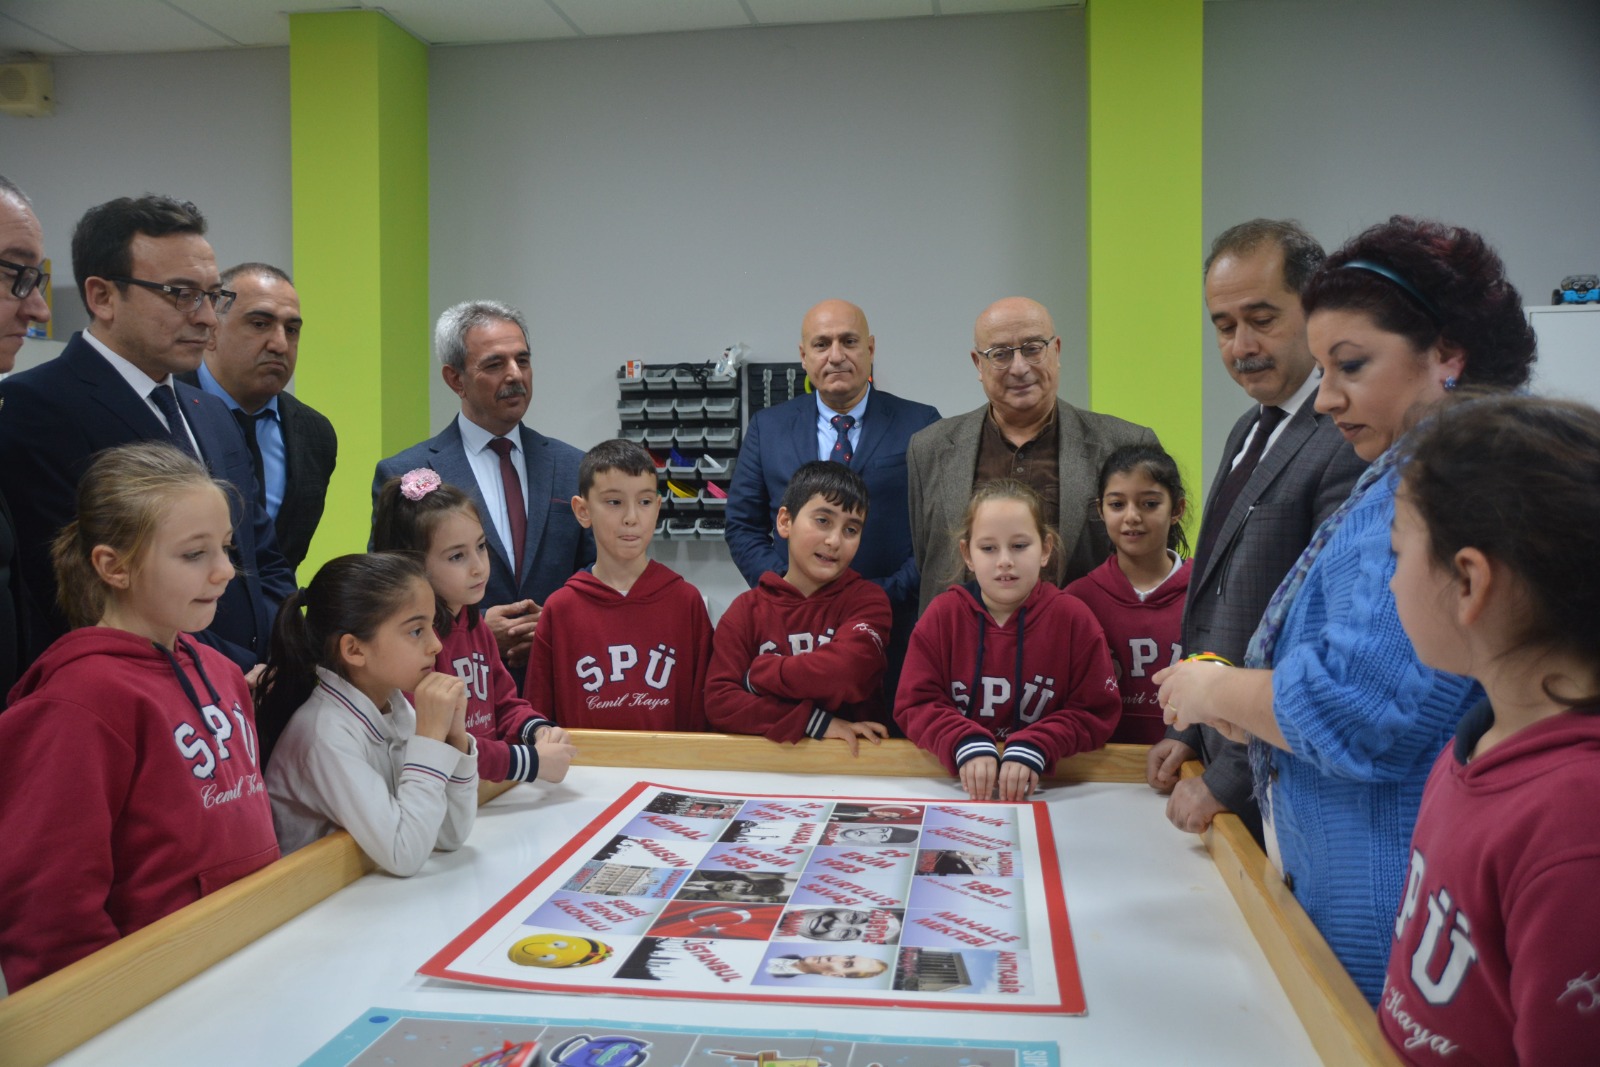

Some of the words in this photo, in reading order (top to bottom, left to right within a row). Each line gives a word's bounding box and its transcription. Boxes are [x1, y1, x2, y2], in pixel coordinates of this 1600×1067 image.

[451, 651, 491, 702] PÜ
[586, 692, 630, 710] Cemil
[628, 691, 671, 711] Kaya
[200, 775, 244, 809] Cemil
[245, 772, 265, 797] Ka
[640, 814, 710, 841] KEMAL
[634, 837, 693, 868] SAMSUN
[709, 853, 759, 870] 1938
[728, 846, 796, 867] KASIM
[774, 846, 805, 855] 10
[838, 851, 896, 869] EKİM
[876, 849, 911, 858] 29
[814, 858, 866, 874] 1923
[802, 883, 863, 906] SAVAŞI
[814, 874, 901, 906] KURTULUŞ
[960, 880, 1013, 898] 1881
[582, 901, 633, 924] EFENDİ
[605, 898, 653, 918] ŞEMSİ
[911, 917, 997, 947] MEKTEBİ
[932, 911, 1021, 943] MAHALLE
[1395, 847, 1478, 1006] PÜ
[682, 941, 743, 983] İSTANBUL
[995, 950, 1025, 994] ANITKABİR
